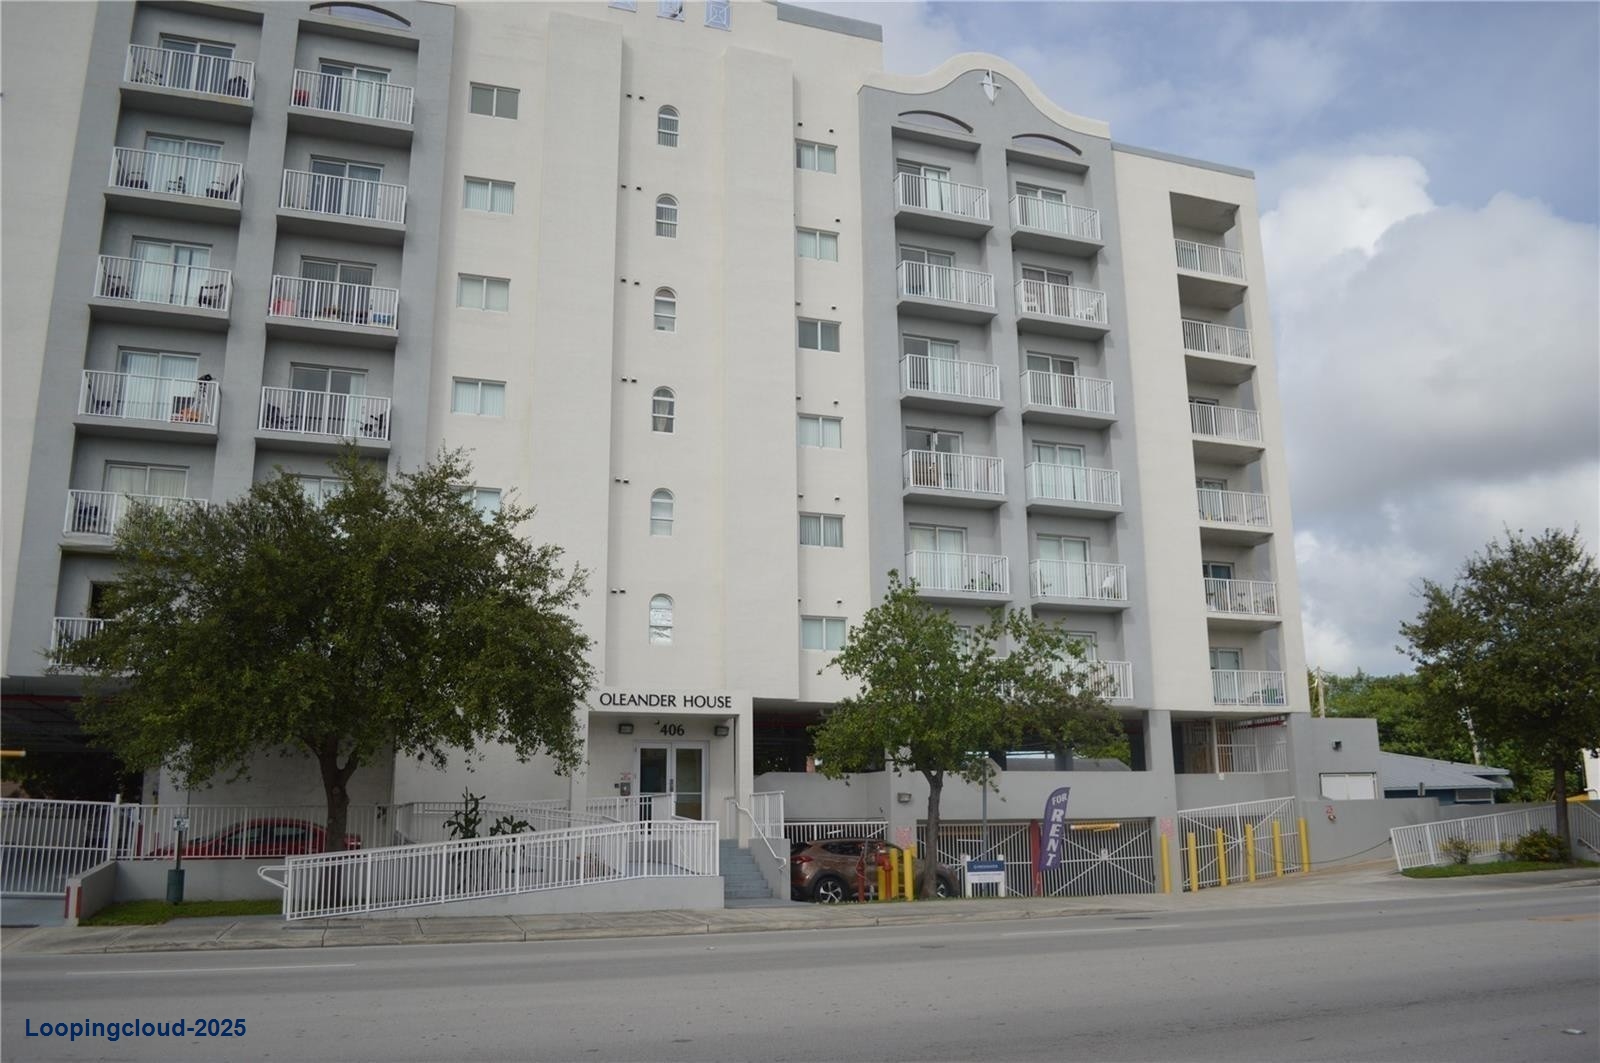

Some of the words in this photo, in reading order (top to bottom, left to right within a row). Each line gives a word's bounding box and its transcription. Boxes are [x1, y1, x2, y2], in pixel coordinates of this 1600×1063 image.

[600, 692, 677, 707] OLEANDER
[683, 695, 732, 708] HOUSE
[659, 724, 685, 736] 406
[1051, 793, 1068, 806] FOR
[1046, 808, 1065, 866] RENT
